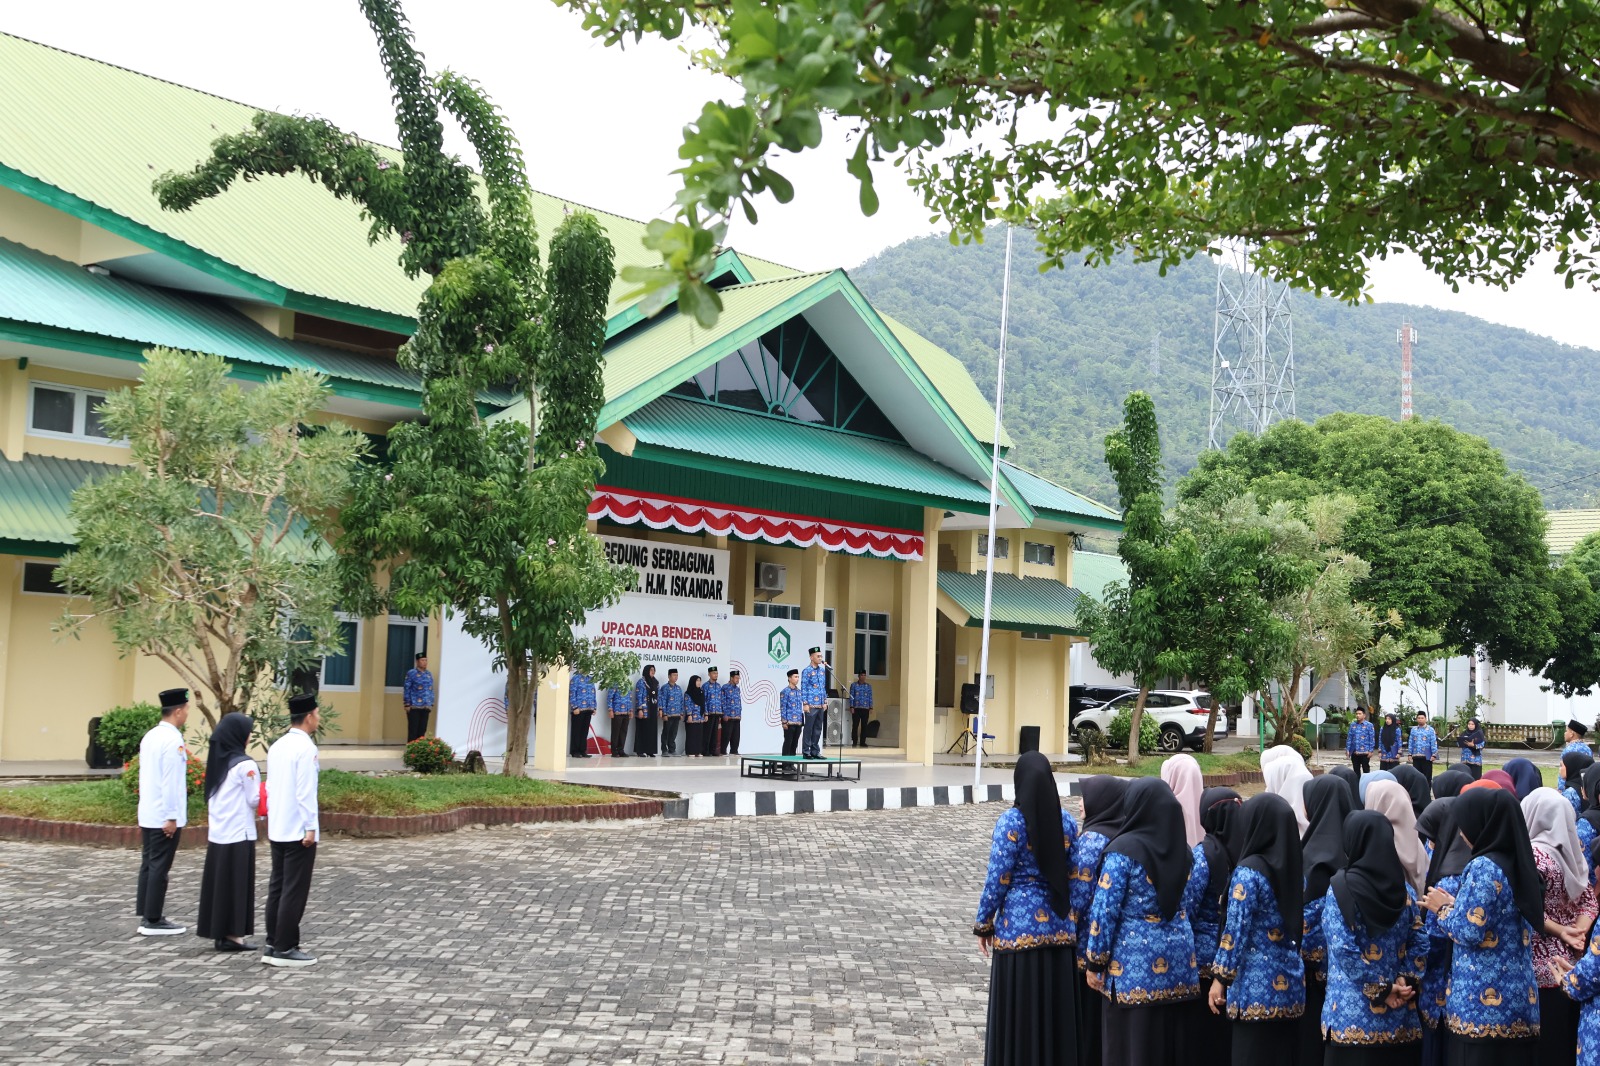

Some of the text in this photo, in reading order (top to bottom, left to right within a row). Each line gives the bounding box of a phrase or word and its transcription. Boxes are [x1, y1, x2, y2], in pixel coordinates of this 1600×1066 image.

[603, 542, 715, 575] GEDUNG SERBAGUNA
[645, 573, 667, 595] H.M.
[670, 575, 723, 600] ISKANDAR
[601, 621, 712, 641] UPACARA BENDERA
[618, 637, 673, 651] KESADARAN
[675, 641, 718, 653] NASIONAL
[643, 653, 663, 662] ISLAM
[663, 654, 686, 664] NEGERI
[686, 656, 711, 665] PALOPO
